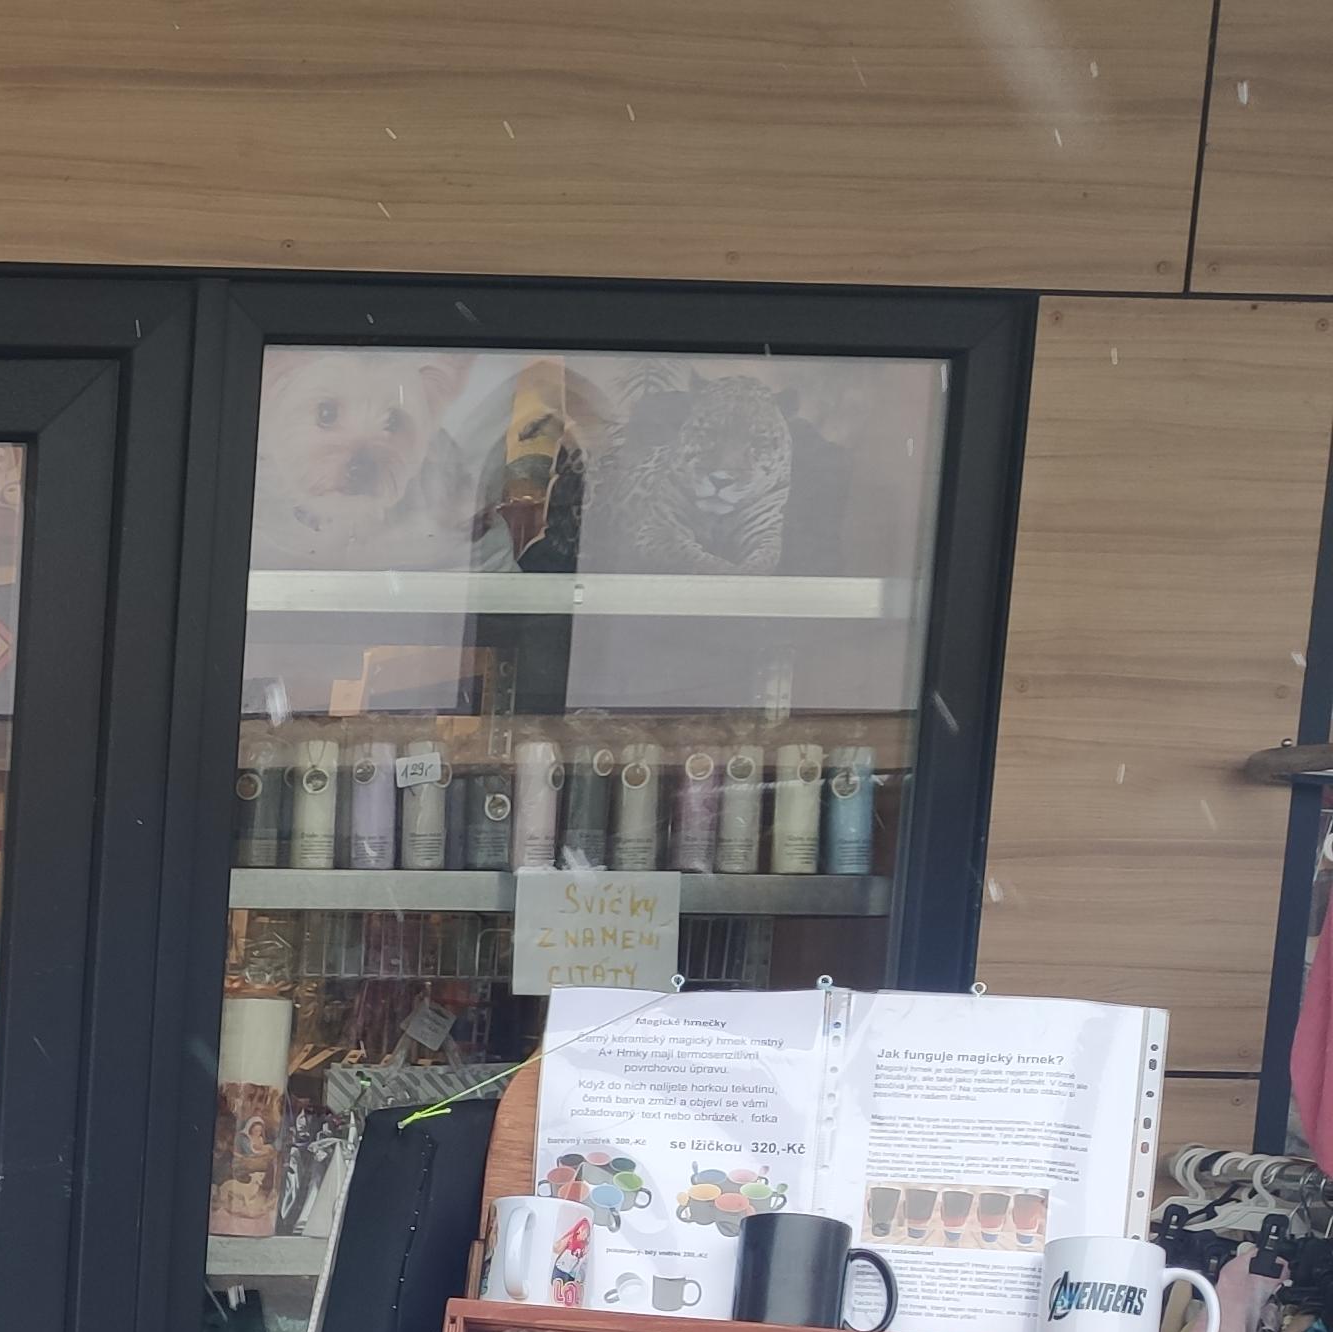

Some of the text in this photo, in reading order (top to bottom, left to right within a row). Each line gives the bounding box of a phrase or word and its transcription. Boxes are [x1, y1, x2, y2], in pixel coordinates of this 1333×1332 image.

[878, 1049, 1064, 1065] Jak funguje magický hrnek?
[670, 1140, 806, 1155] se lžičkou 320,-Kč
[1048, 1271, 1147, 1322] AVENGERS
